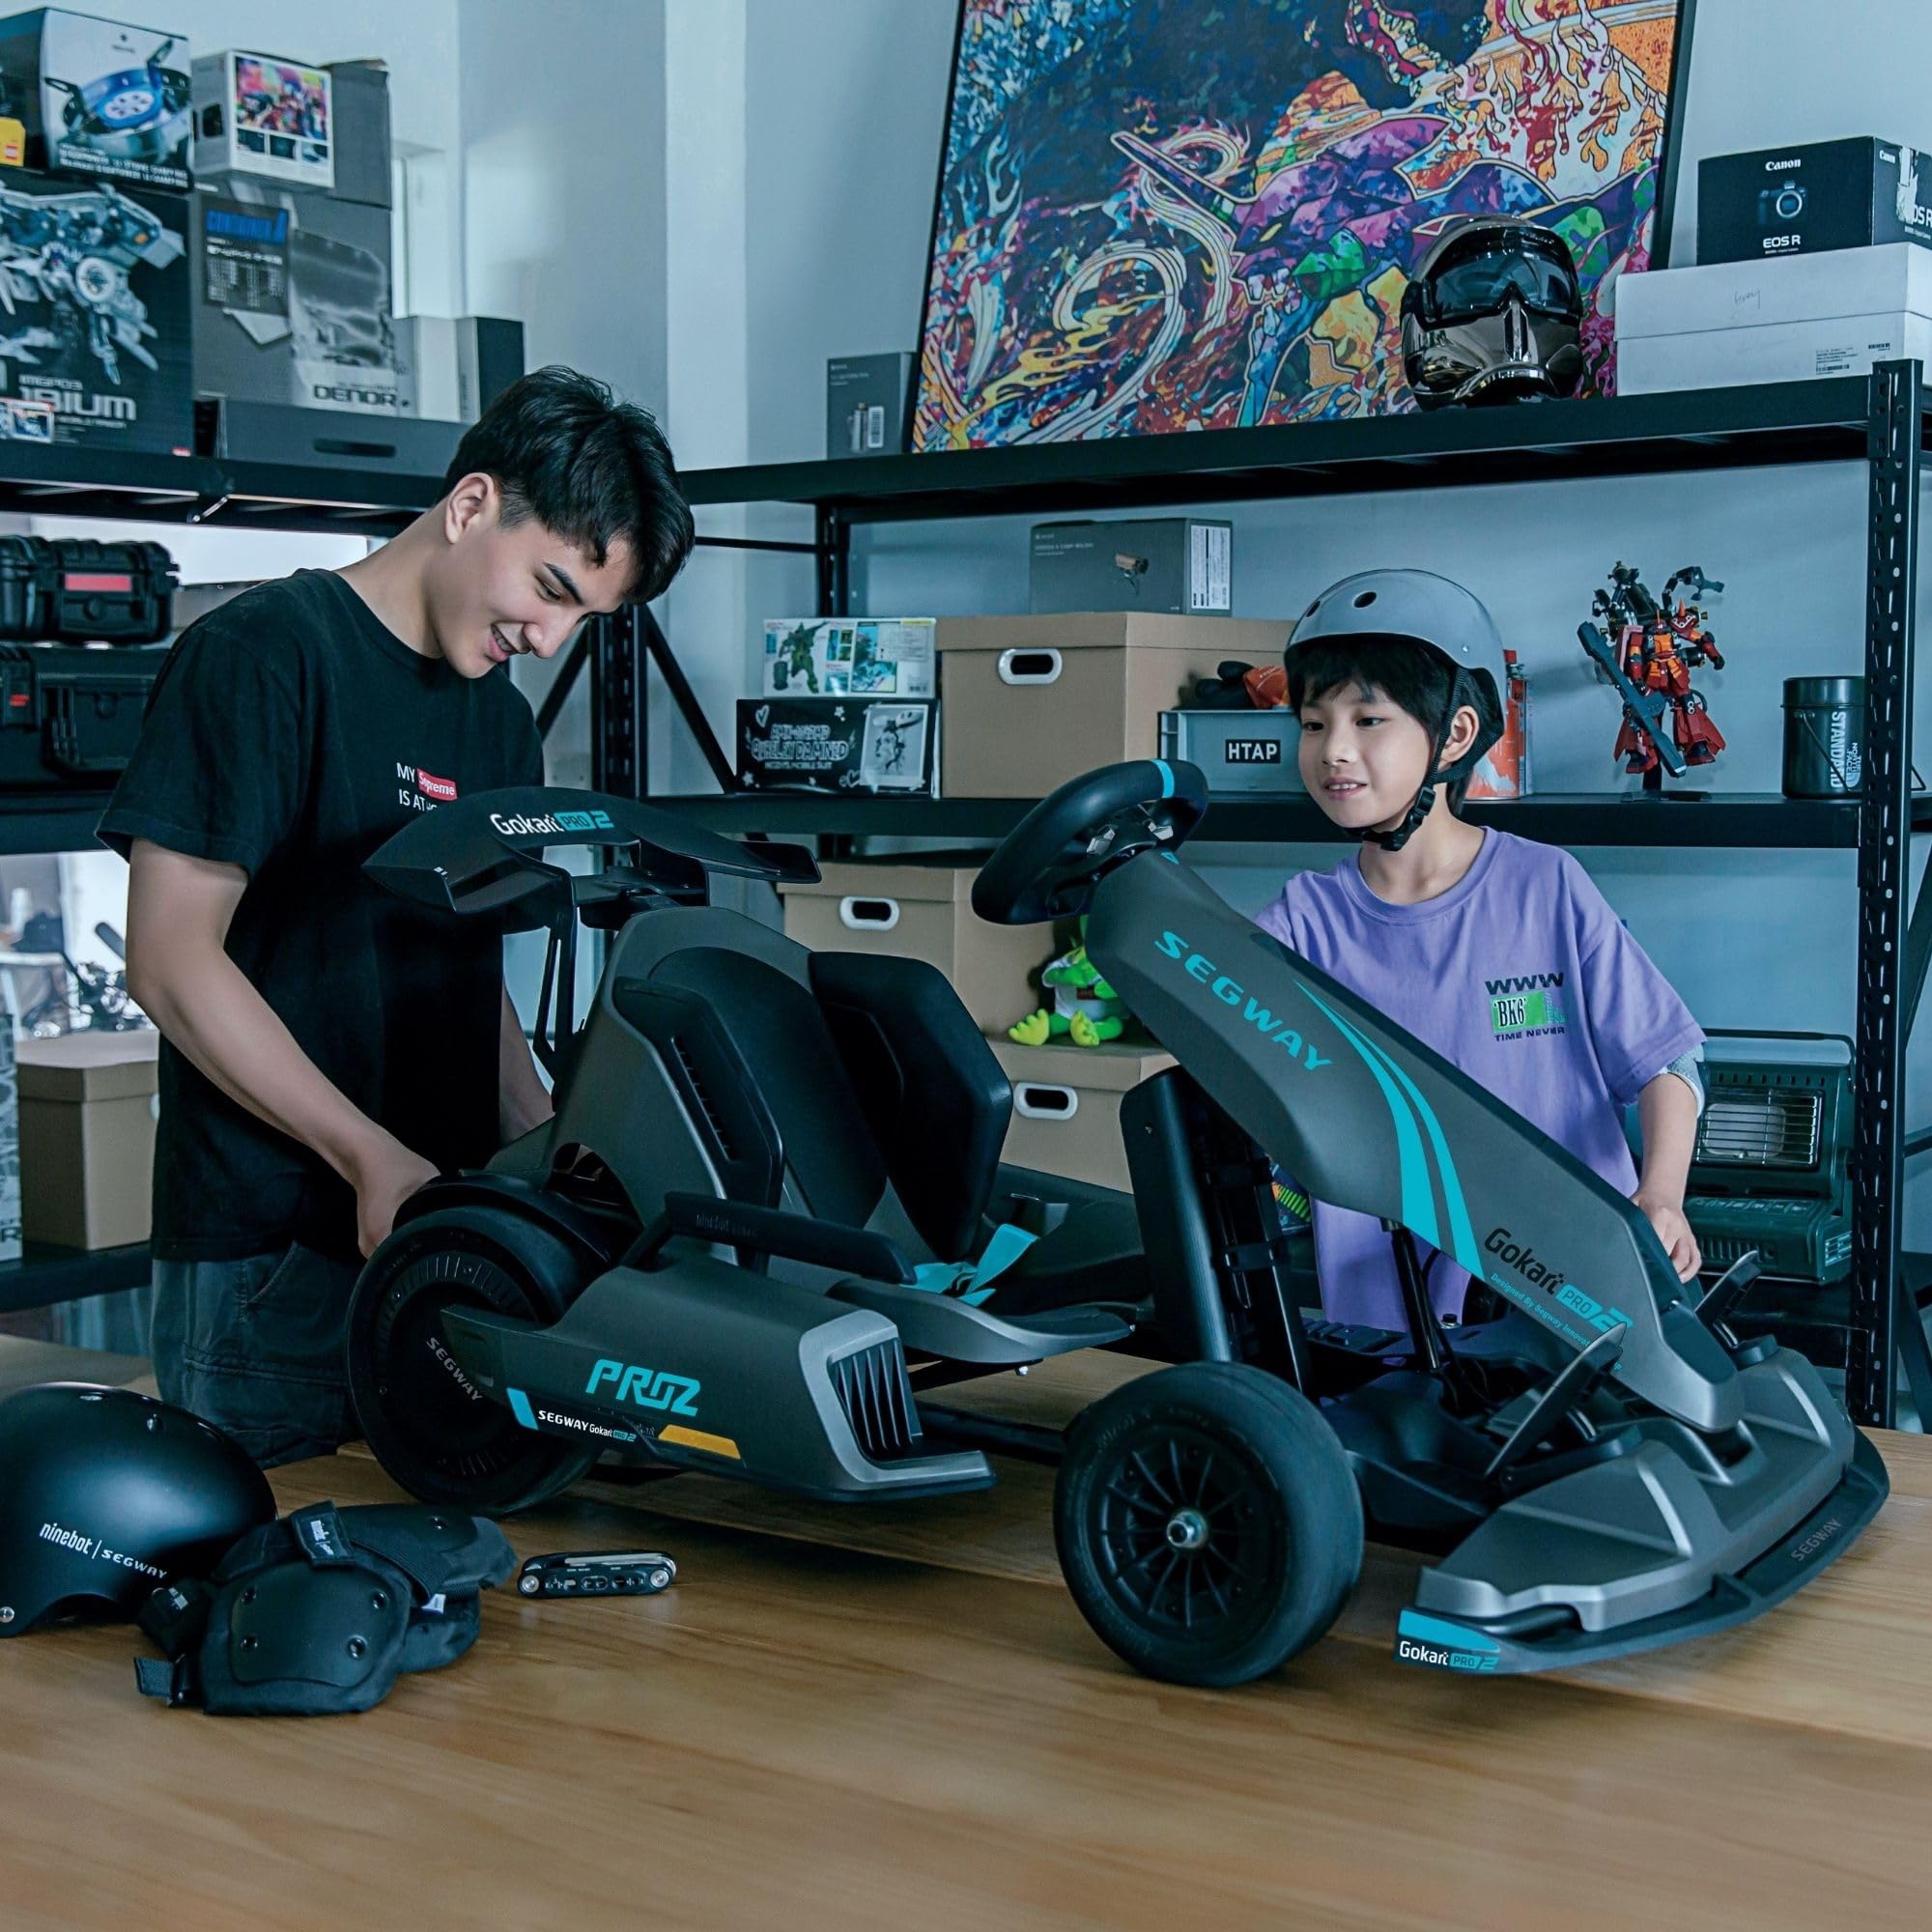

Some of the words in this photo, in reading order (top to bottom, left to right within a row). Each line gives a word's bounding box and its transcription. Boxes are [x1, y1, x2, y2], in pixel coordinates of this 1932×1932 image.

[1765, 158, 1802, 172] Canon
[1878, 149, 1896, 164] Canon
[1763, 236, 1790, 248] EOS
[1791, 235, 1802, 245] R
[1228, 742, 1278, 760] HTAP
[396, 761, 415, 783] MY
[418, 772, 455, 796] Supreme
[398, 788, 411, 807] IS
[412, 794, 426, 812] AT
[490, 813, 564, 835] Gokart
[557, 813, 593, 830] PRO
[1485, 972, 1565, 996] WWW
[1153, 930, 1333, 1070] SEGWAY
[1494, 1031, 1522, 1042] TIME
[1526, 1026, 1566, 1038] NEVER
[1484, 1228, 1565, 1295] Gokart
[1560, 1287, 1597, 1317] PRO
[1491, 1272, 1525, 1300] Designed
[1523, 1295, 1537, 1309] By
[1535, 1304, 1563, 1329] Segway
[425, 1337, 483, 1401] SEGWAY
[537, 1408, 589, 1433] SEGWAY
[588, 1422, 613, 1438] Gokart
[40, 1522, 93, 1555] ninebot
[100, 1548, 168, 1579] SEGWAY
[1790, 1517, 1842, 1562] SEGWAY
[1400, 1640, 1449, 1665] Gokart
[1452, 1654, 1477, 1668] PRO
